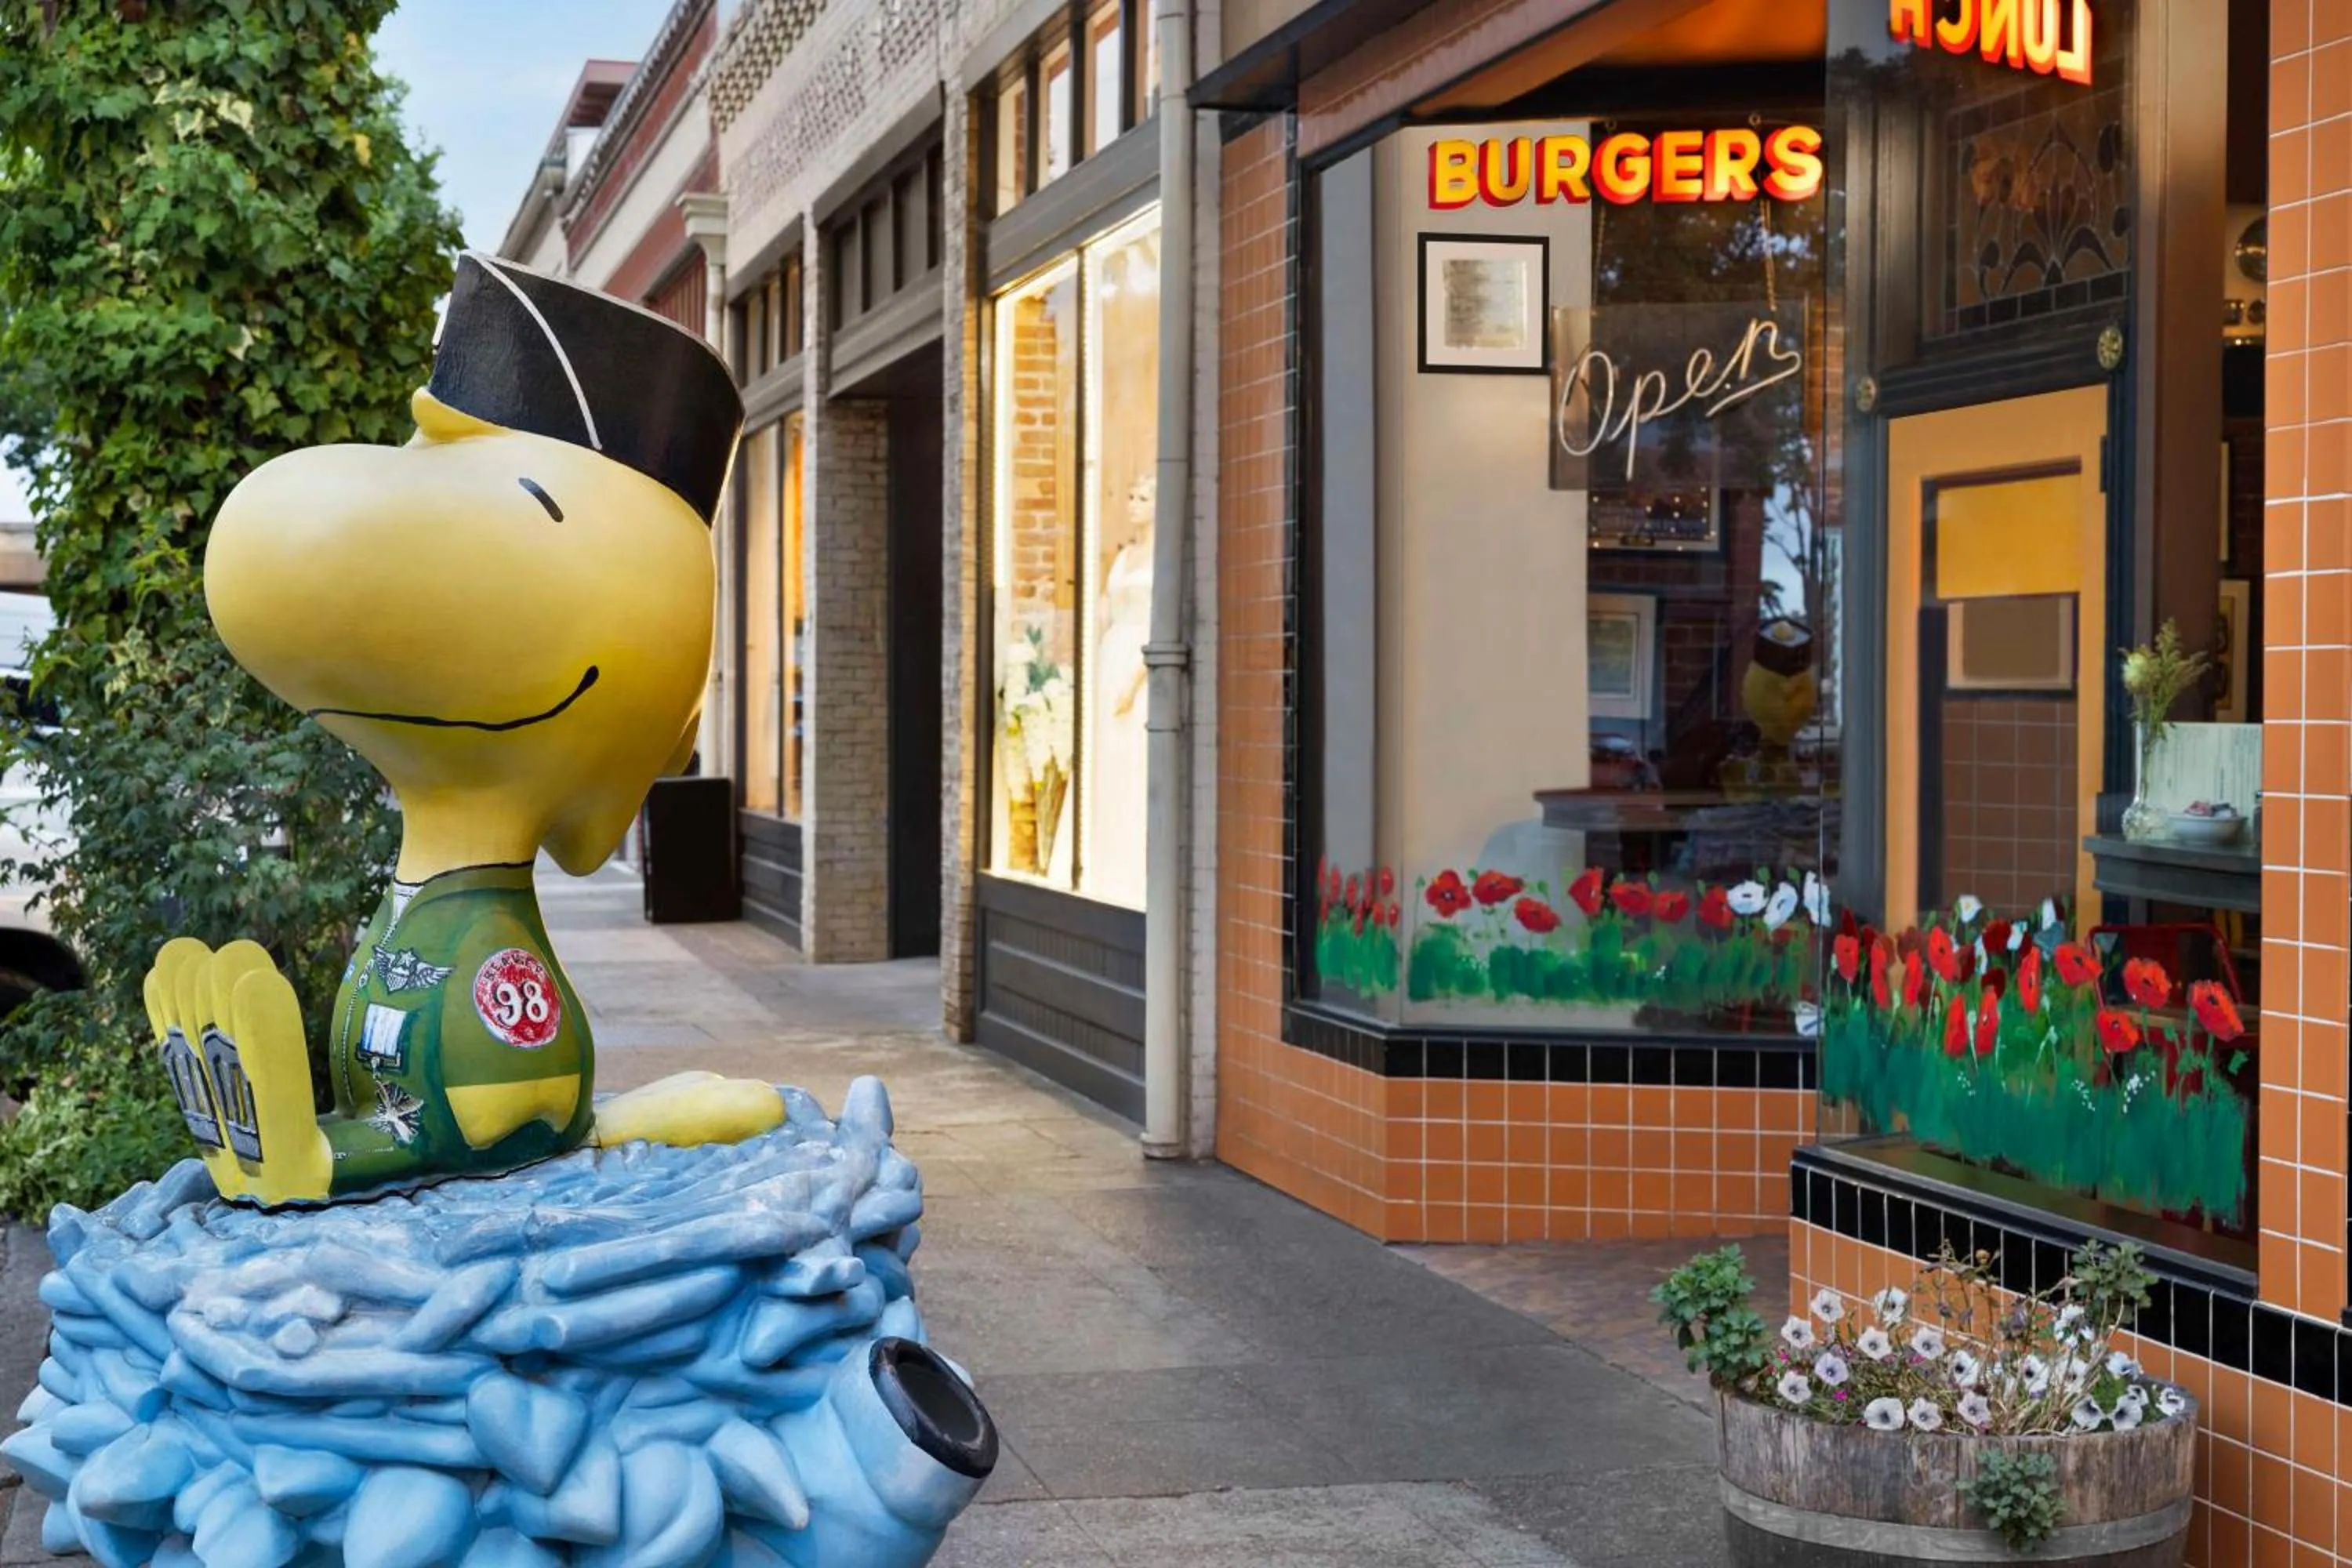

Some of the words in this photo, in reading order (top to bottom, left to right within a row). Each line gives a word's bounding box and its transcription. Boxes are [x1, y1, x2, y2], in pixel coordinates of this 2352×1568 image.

[1428, 125, 1824, 211] BURGERS
[1558, 318, 1802, 481] Open
[493, 980, 549, 1029] 98
